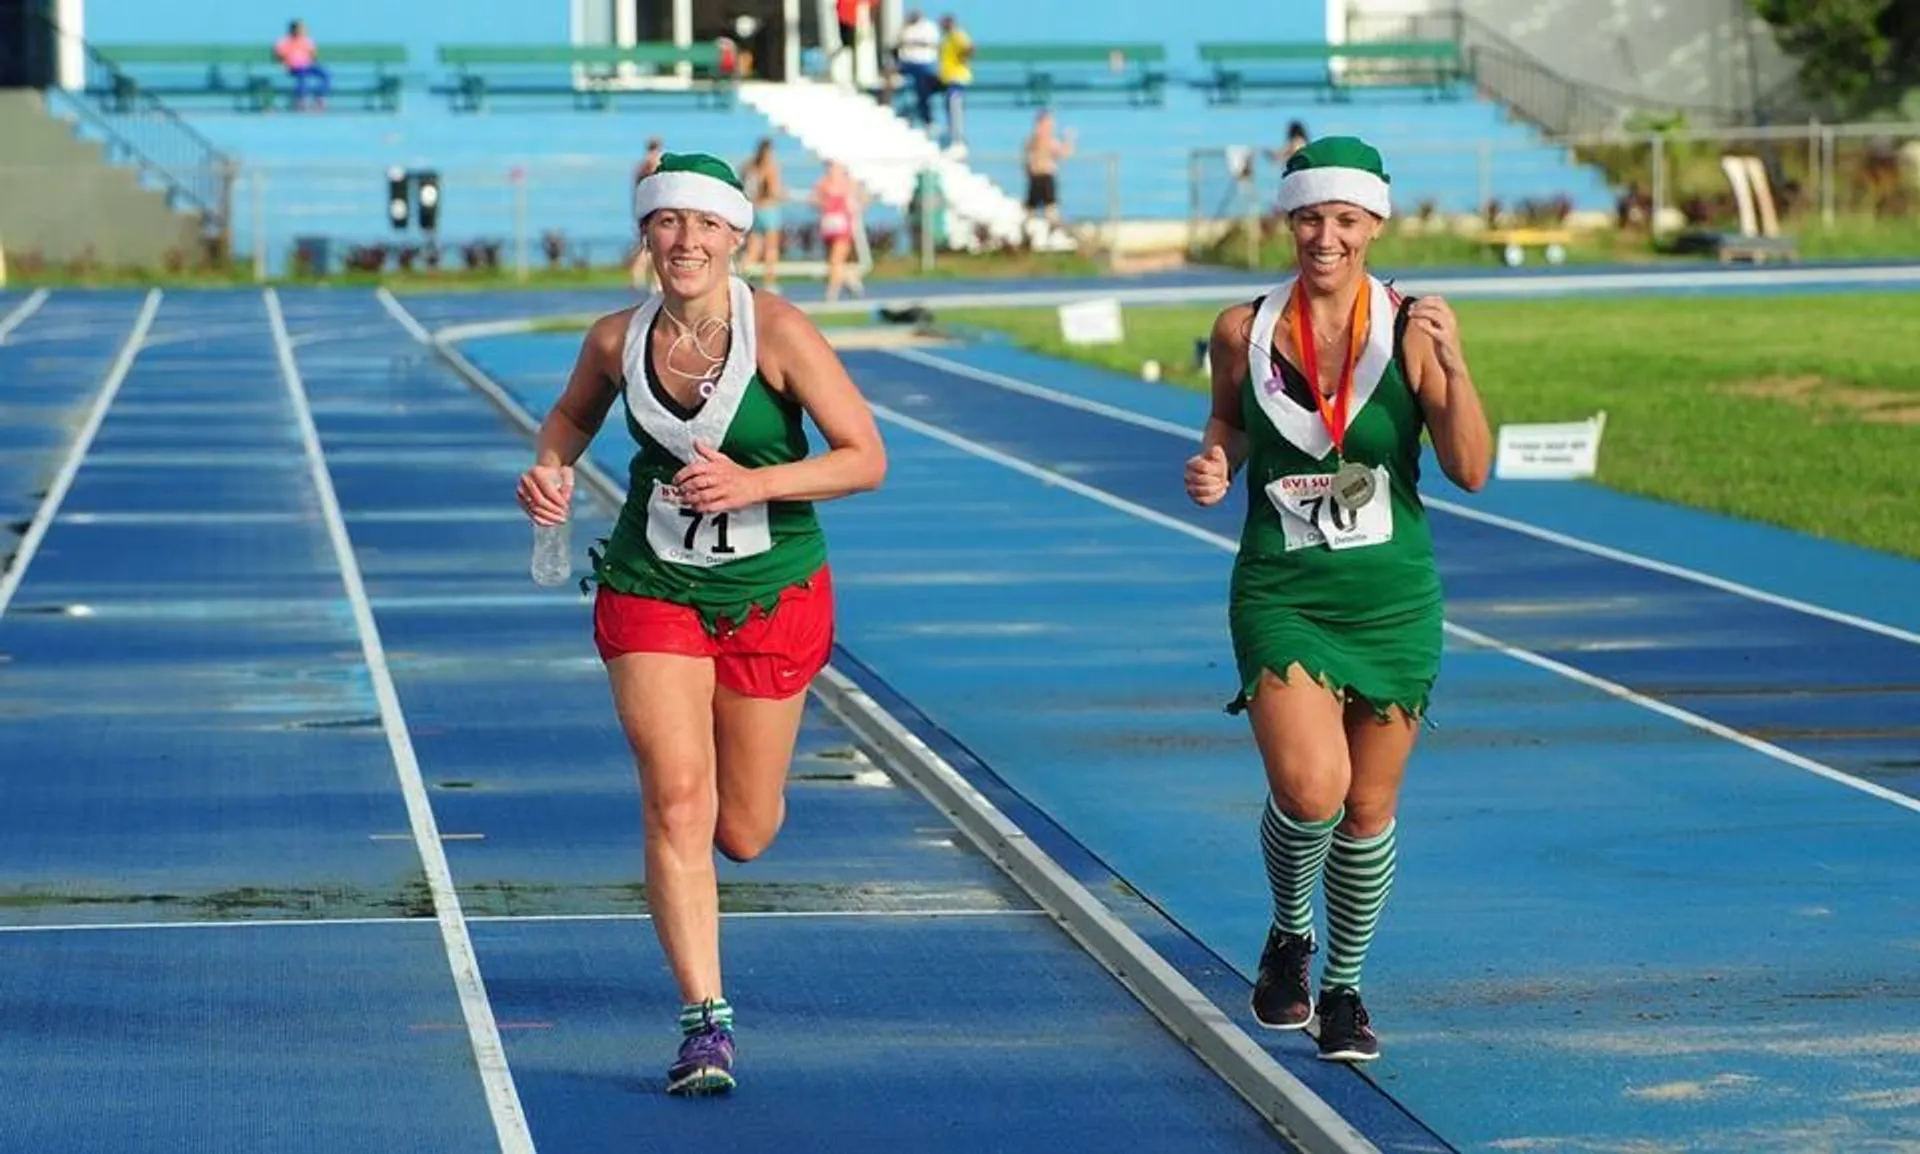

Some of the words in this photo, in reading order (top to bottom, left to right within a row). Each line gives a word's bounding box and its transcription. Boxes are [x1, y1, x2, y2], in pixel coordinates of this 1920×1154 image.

[1282, 478, 1307, 489] BVI
[1311, 477, 1330, 488] SU
[678, 508, 735, 554] 71
[1300, 496, 1357, 532] 70
